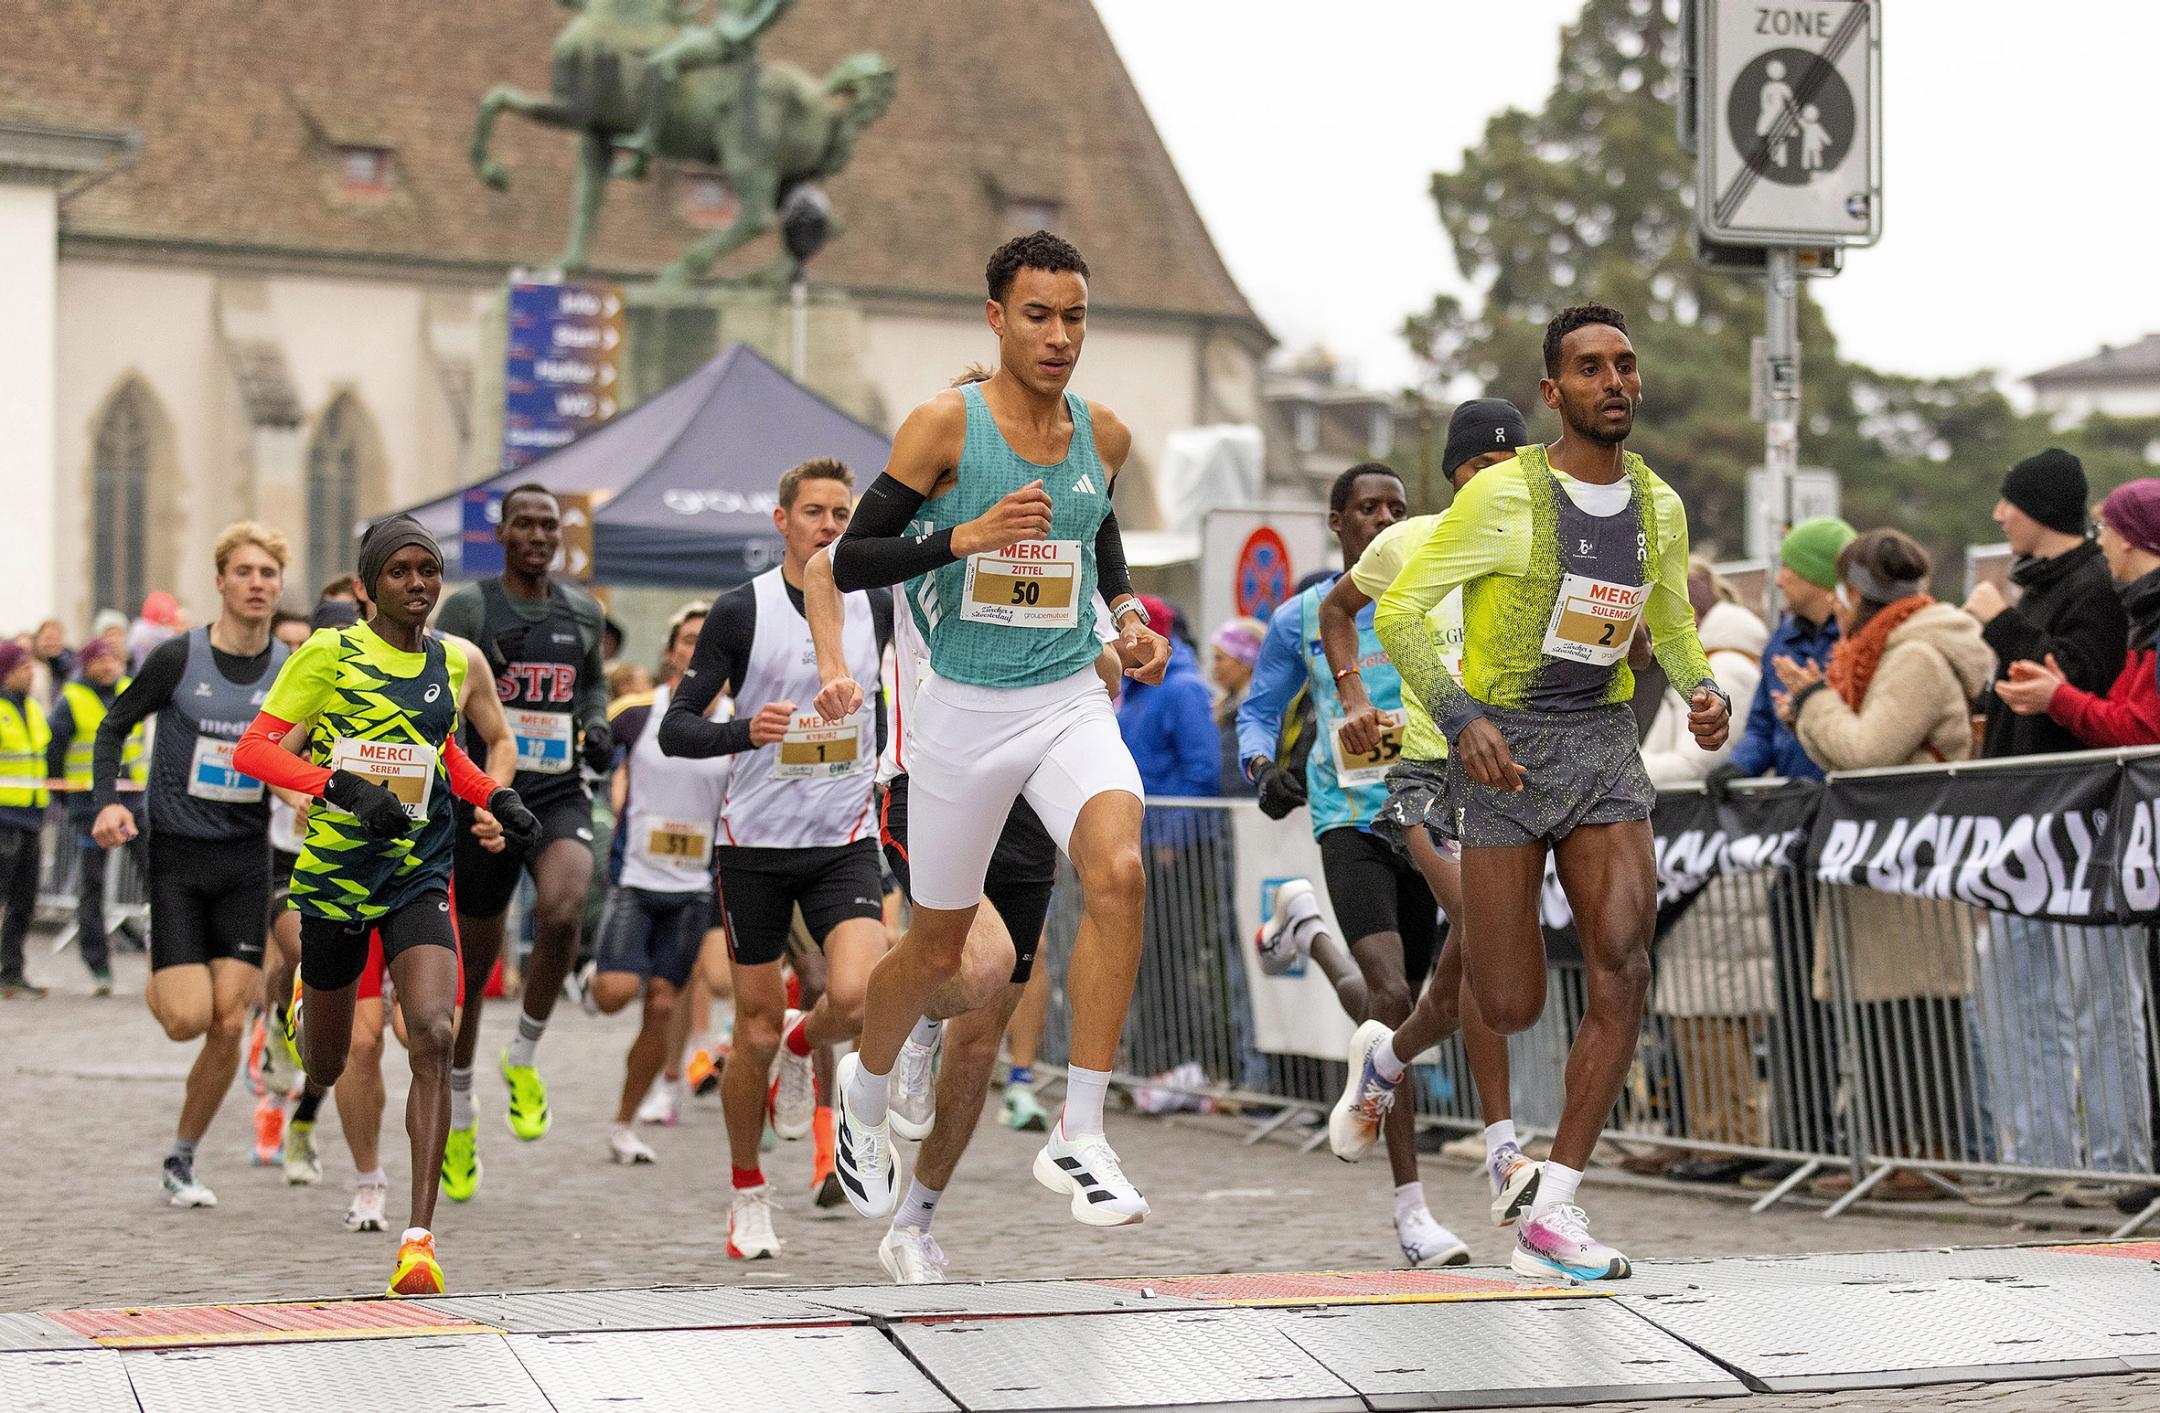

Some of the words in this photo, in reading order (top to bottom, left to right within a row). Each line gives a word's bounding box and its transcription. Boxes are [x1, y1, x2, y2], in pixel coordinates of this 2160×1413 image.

[1755, 7, 1832, 38] ZONE
[1000, 543, 1058, 560] MERCI
[1011, 565, 1044, 576] ZITTEL
[1011, 581, 1040, 605] 50
[1589, 584, 1641, 605] MERC
[1599, 623, 1616, 646] 2
[360, 744, 413, 762] MERCI
[817, 744, 826, 762] 1
[370, 764, 401, 775] SEREM
[1817, 812, 2093, 916] BLACKROLL
